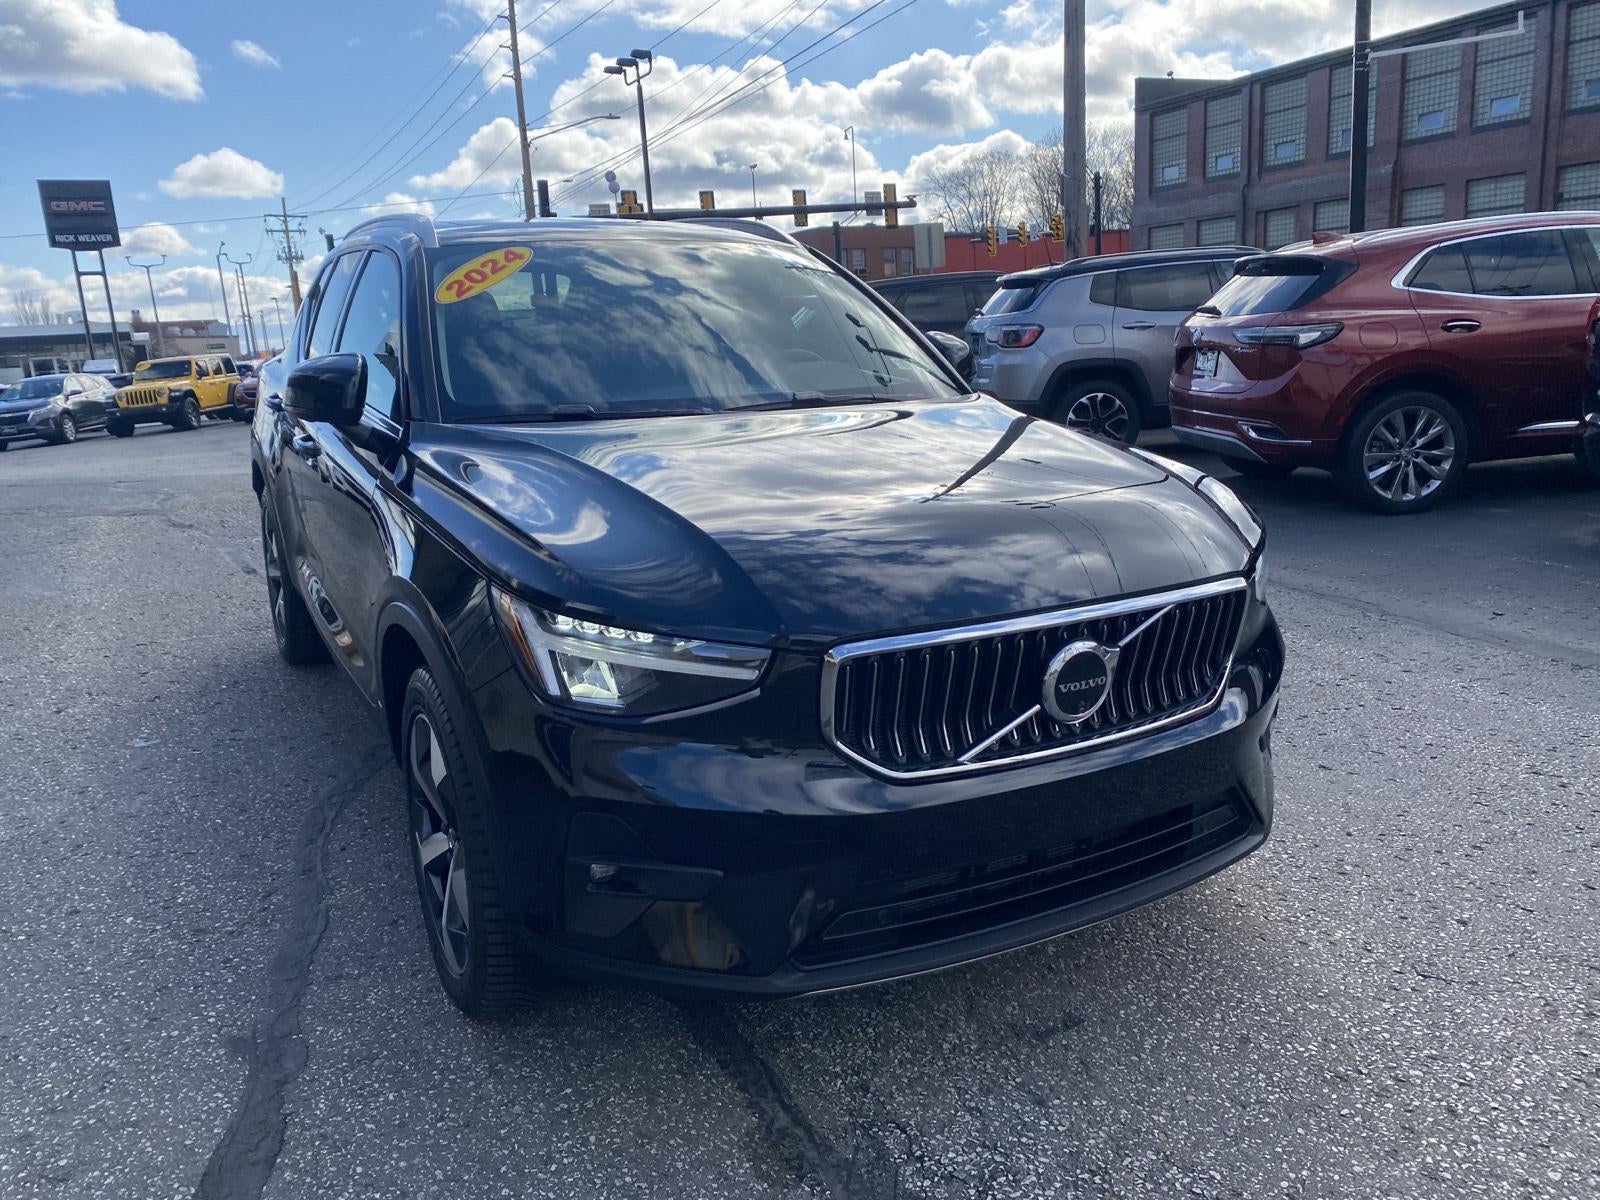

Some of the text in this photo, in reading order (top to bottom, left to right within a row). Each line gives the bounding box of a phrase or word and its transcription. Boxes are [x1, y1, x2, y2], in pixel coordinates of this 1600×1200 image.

[50, 201, 106, 211] GMC
[55, 234, 113, 242] RICK WEAVER
[445, 249, 525, 299] 2024
[1058, 676, 1106, 693] VOLVO
